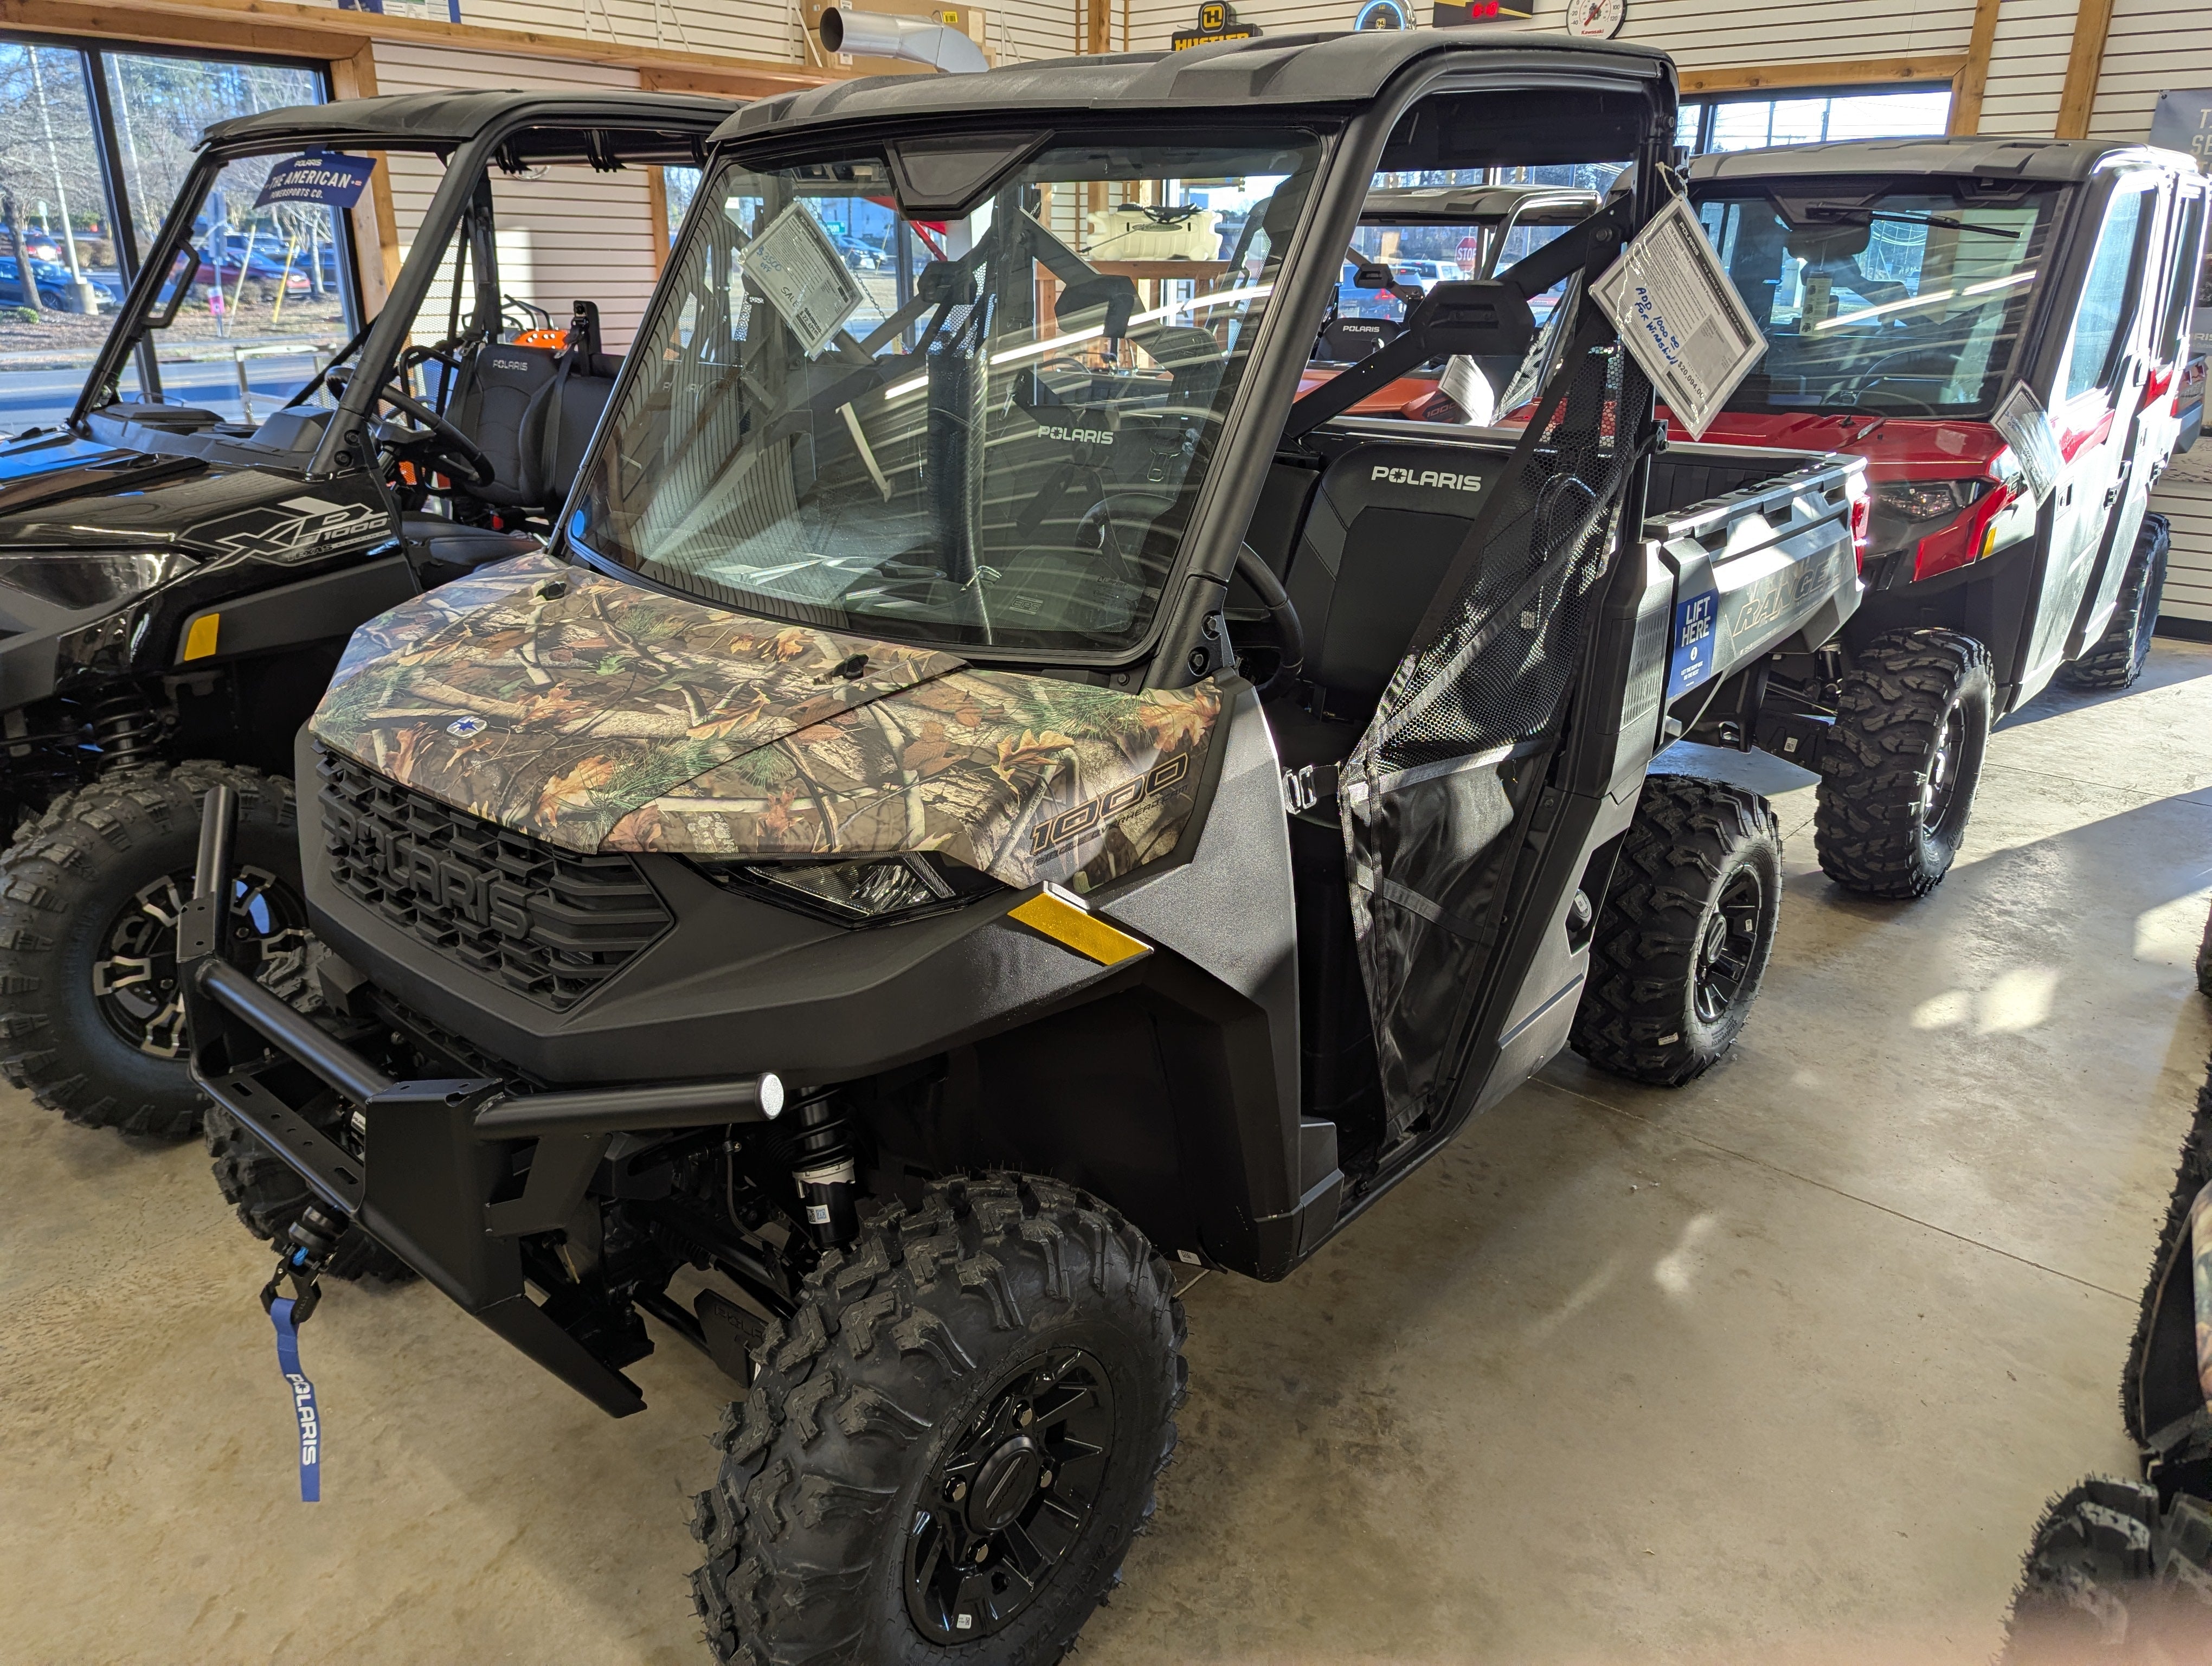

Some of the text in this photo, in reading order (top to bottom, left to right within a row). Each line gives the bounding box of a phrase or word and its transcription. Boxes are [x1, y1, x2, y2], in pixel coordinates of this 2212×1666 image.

[294, 159, 323, 167] POLARIS
[269, 170, 352, 189] THE AMERICAN
[270, 189, 323, 199] POWERSPORTS CO.
[756, 246, 783, 272] $3500
[1457, 247, 1476, 261] STOP
[1679, 221, 1700, 255] POLARIS
[1707, 273, 1718, 289] WORLD
[1716, 290, 1728, 306] LEADER
[760, 262, 773, 273] OFF
[1673, 234, 1684, 252] RANGER
[1688, 260, 1699, 278] Premium
[1697, 277, 1707, 291] Polaris
[1705, 290, 1714, 304] Pursuit
[1713, 304, 1721, 315] Camo
[780, 286, 800, 309] SALE
[1633, 300, 1650, 322] FOR
[1635, 286, 1652, 311] ADD
[1652, 313, 1669, 338] 1000
[493, 359, 528, 371] POLARIS
[1676, 361, 1706, 400] $20,094.00
[1038, 425, 1114, 445] POLARIS
[1371, 465, 1482, 492] POLARIS
[324, 517, 388, 541] 1000
[286, 543, 333, 562] TEXAS
[1012, 599, 1041, 612] EPS
[1732, 550, 1846, 637] RANGER
[1686, 596, 1711, 625] LIFT
[1681, 616, 1711, 648] HERE
[1029, 752, 1191, 856] 1000
[1033, 785, 1189, 868] SINGLE OVERHEAD CAM
[333, 803, 531, 941] POLARIS
[286, 1373, 317, 1466] POLARIS
